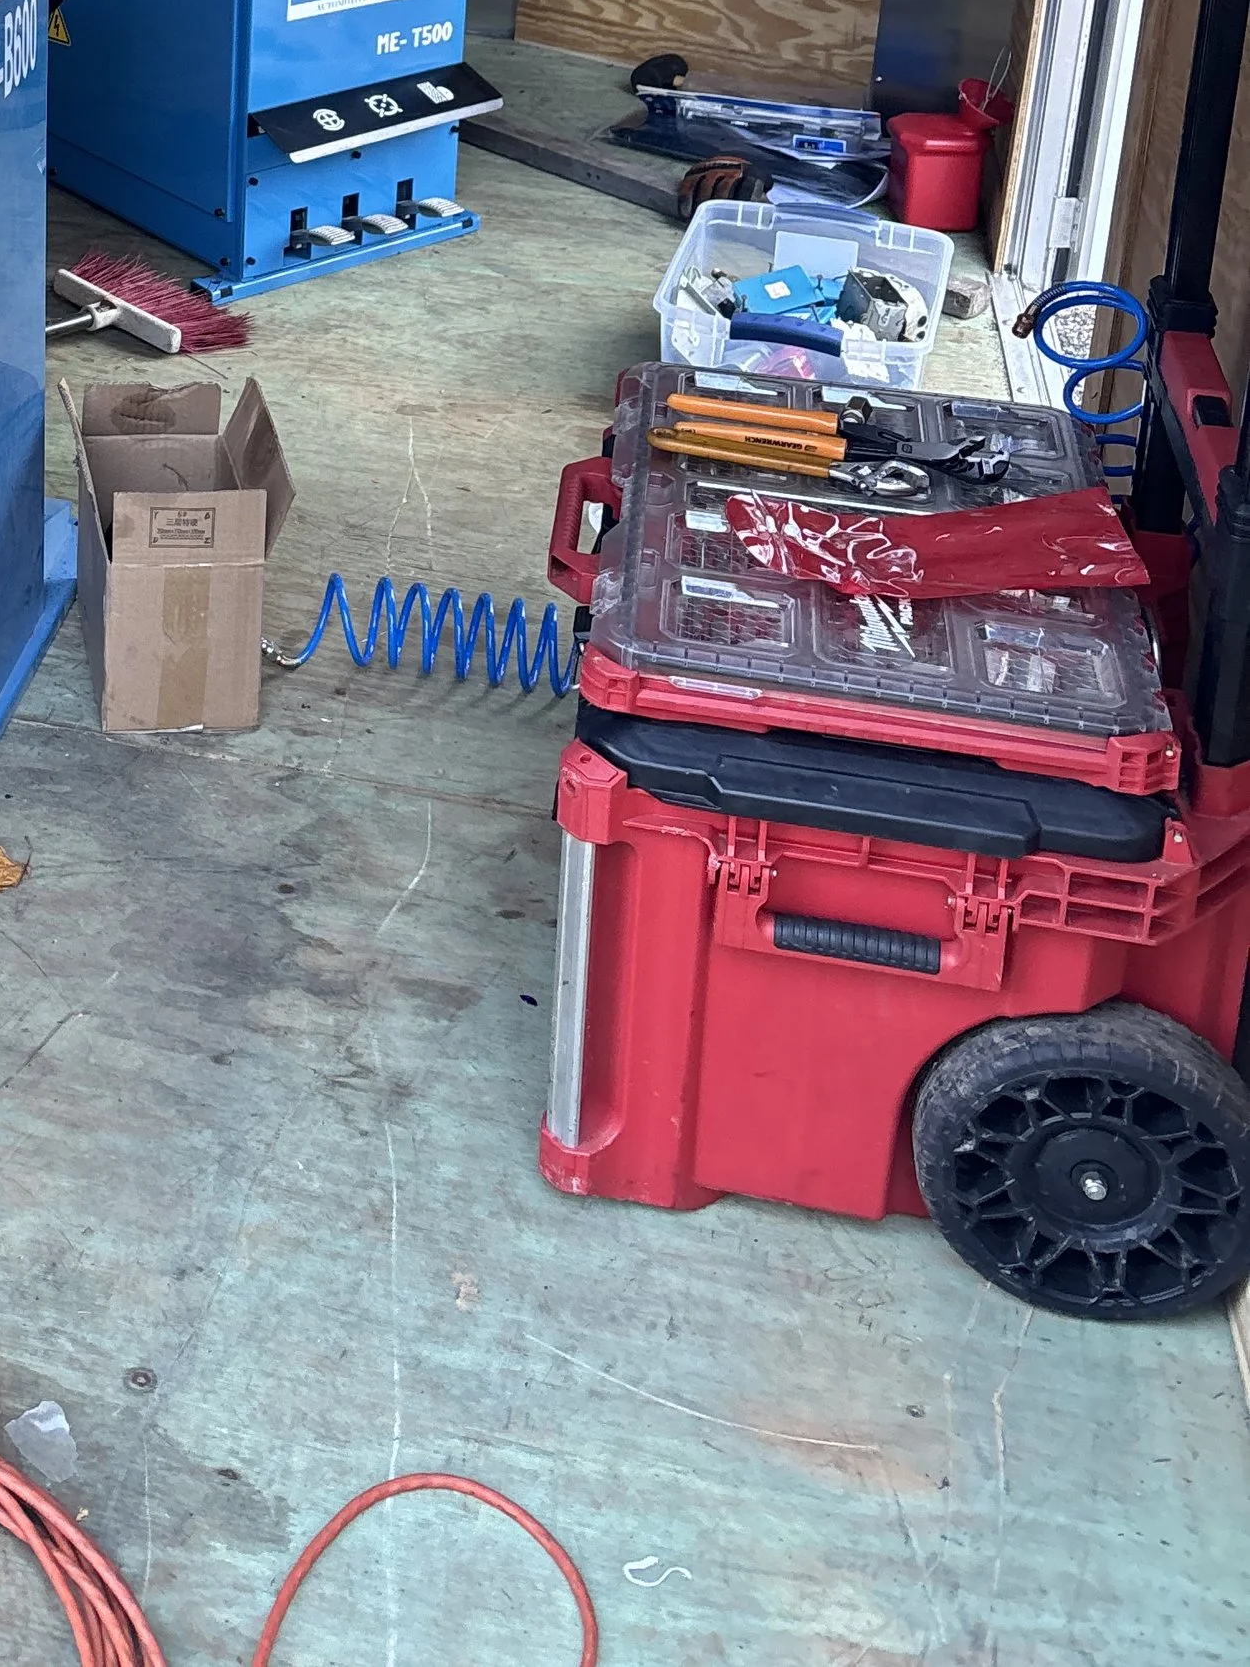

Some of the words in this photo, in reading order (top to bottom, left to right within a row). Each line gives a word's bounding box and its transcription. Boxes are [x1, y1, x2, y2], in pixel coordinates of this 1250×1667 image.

[411, 20, 453, 48] T500
[744, 435, 803, 451] GEARWRENCH
[849, 593, 902, 653] Milwauke
